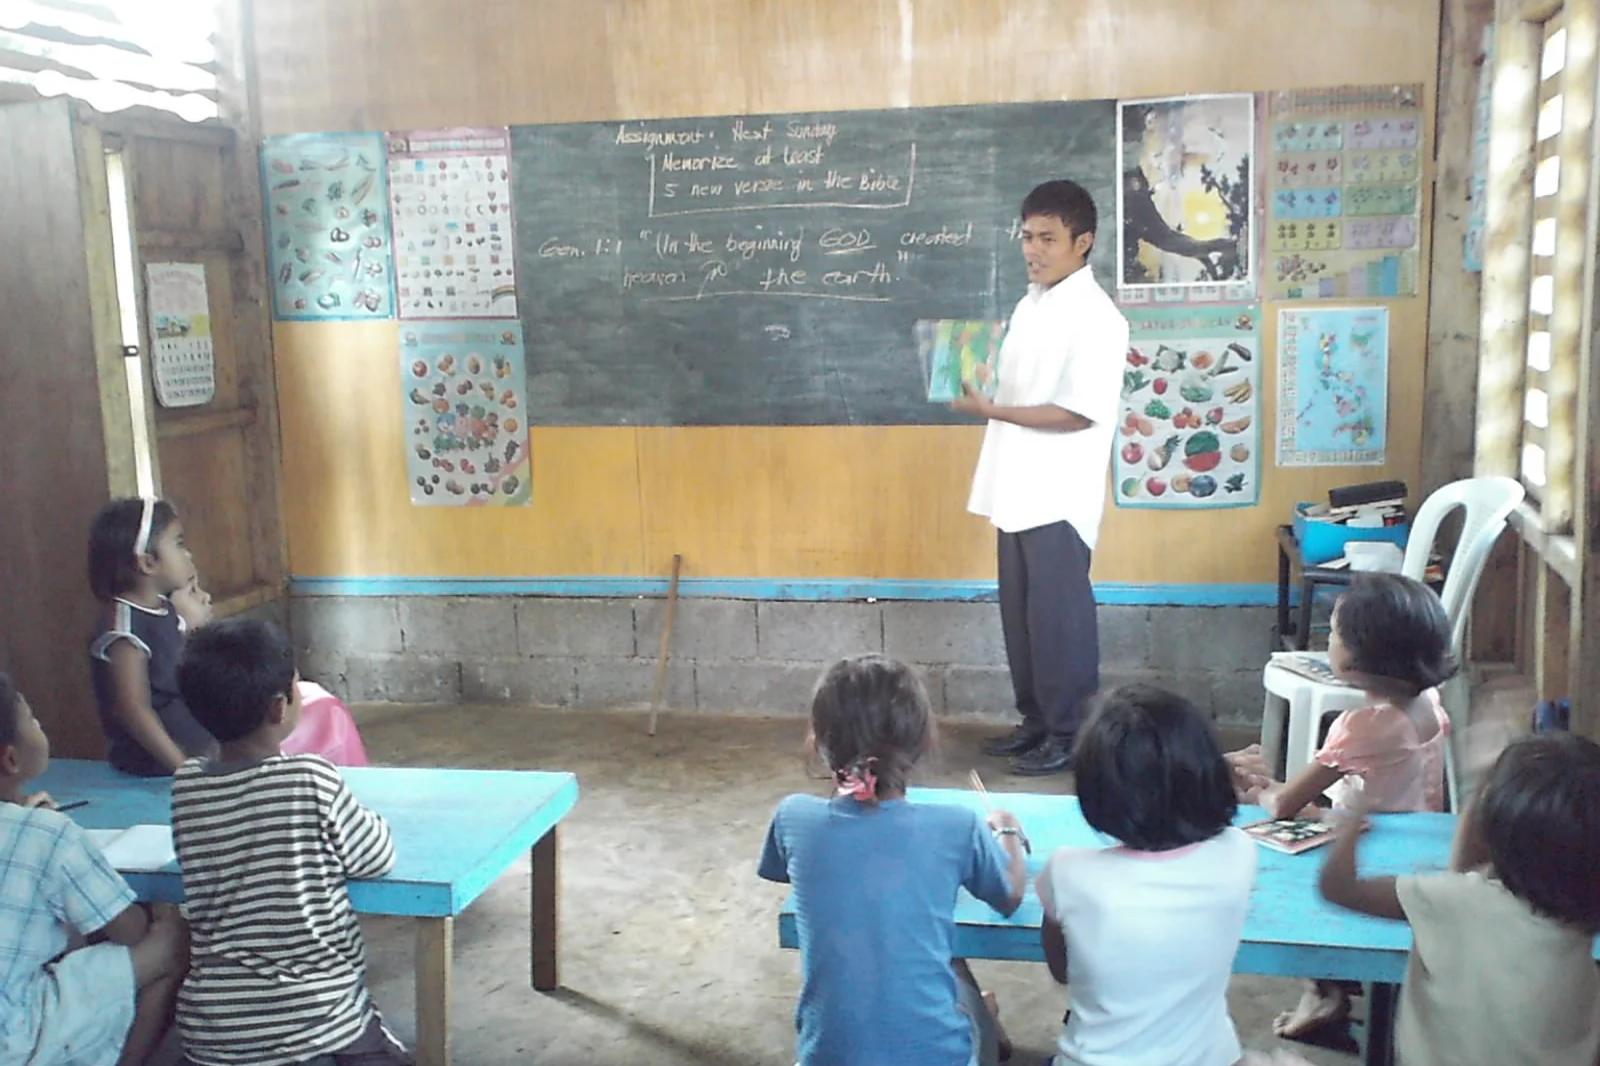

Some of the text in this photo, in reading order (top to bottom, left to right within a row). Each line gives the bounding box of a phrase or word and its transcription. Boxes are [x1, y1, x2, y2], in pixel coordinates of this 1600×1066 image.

[787, 119, 838, 146] Sunday
[662, 151, 738, 172] Memorize
[754, 145, 774, 166] at
[664, 182, 679, 197] 5
[691, 183, 722, 196] new
[797, 170, 814, 191] in
[824, 170, 853, 189] the
[859, 168, 901, 191] Bible
[595, 238, 623, 256] 1:1
[684, 230, 714, 252] the
[818, 227, 878, 250] GOD
[900, 222, 973, 247] created
[760, 267, 807, 291] the
